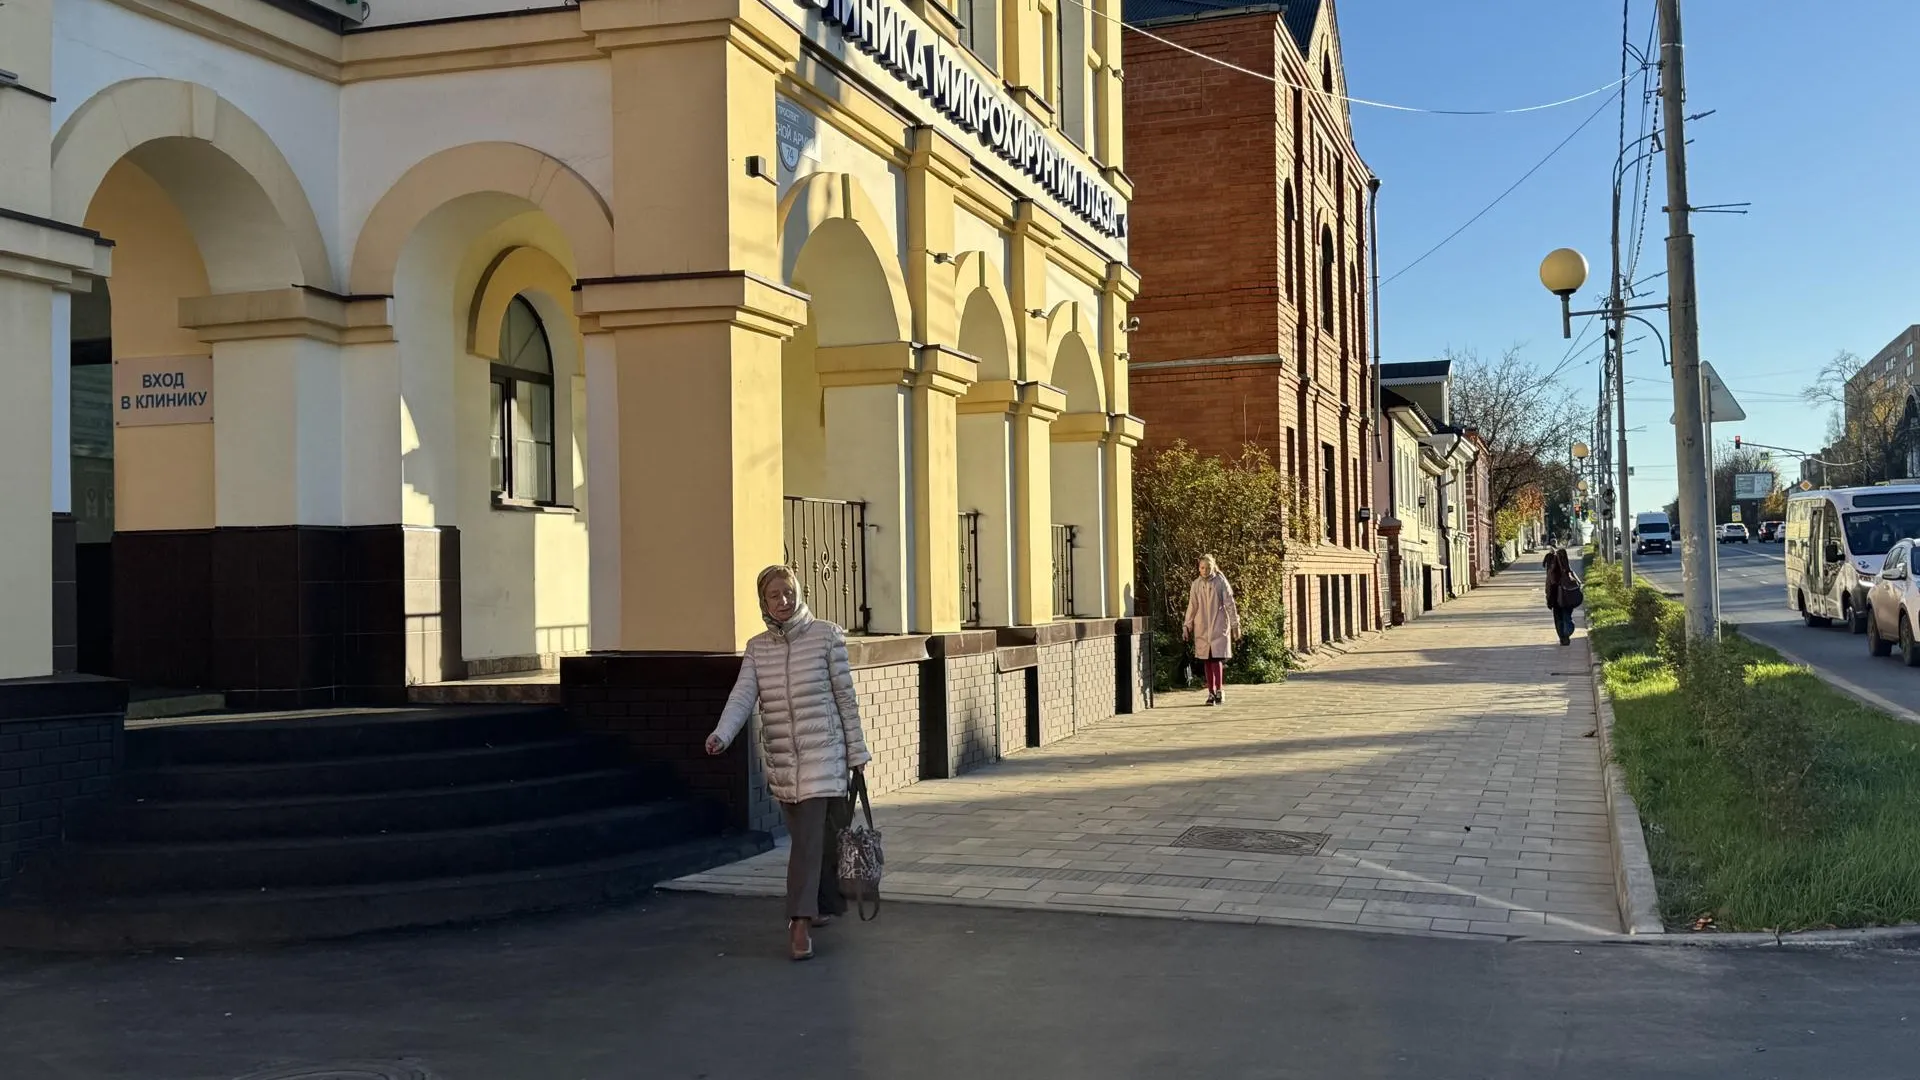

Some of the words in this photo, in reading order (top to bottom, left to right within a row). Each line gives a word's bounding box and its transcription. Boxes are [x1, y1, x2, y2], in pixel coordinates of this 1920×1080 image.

[932, 45, 1077, 206] МИКРОХИРУРГИИ
[1080, 173, 1118, 238] ГЛАЗА
[142, 372, 185, 389] ВХОД
[121, 395, 132, 409] В
[136, 391, 208, 409] КЛИНИКУ
